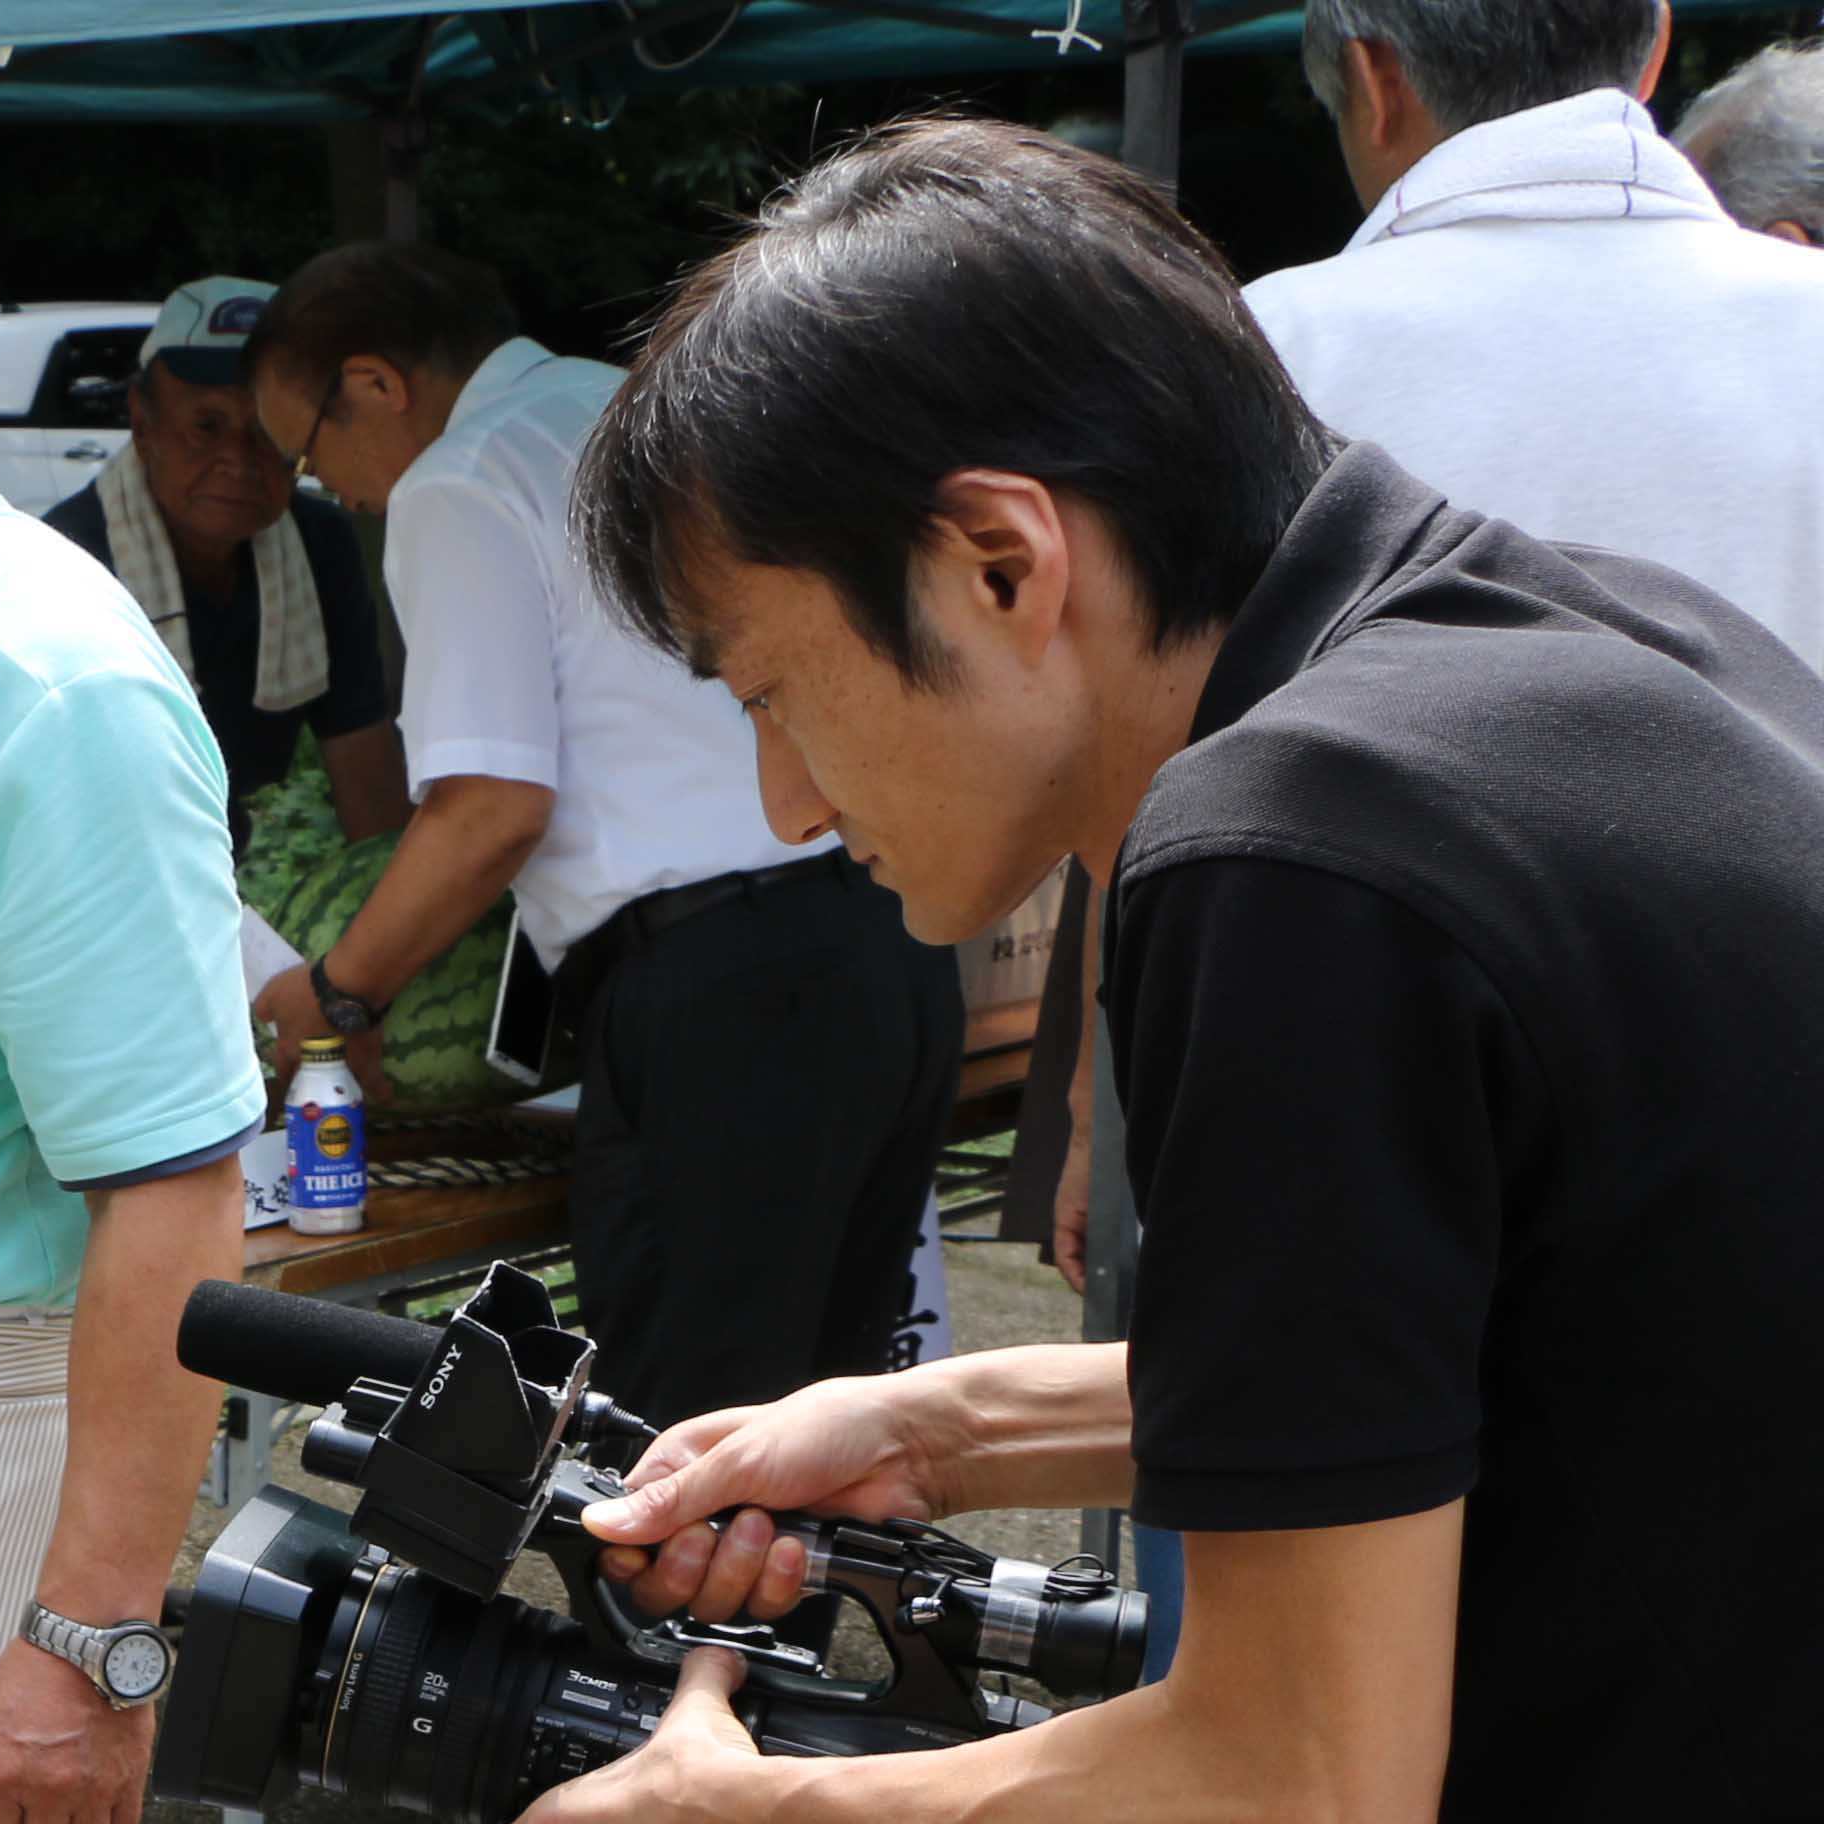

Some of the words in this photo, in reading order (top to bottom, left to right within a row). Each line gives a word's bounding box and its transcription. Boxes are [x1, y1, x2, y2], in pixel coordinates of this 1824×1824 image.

[303, 1173, 340, 1192] THE
[419, 1342, 463, 1411] SONY
[352, 1651, 365, 1662] G
[346, 1661, 361, 1686] Lens
[423, 1671, 450, 1690] 20x
[566, 1669, 619, 1692] 3CMOS
[338, 1683, 355, 1712] Sony
[412, 1717, 433, 1735] G
